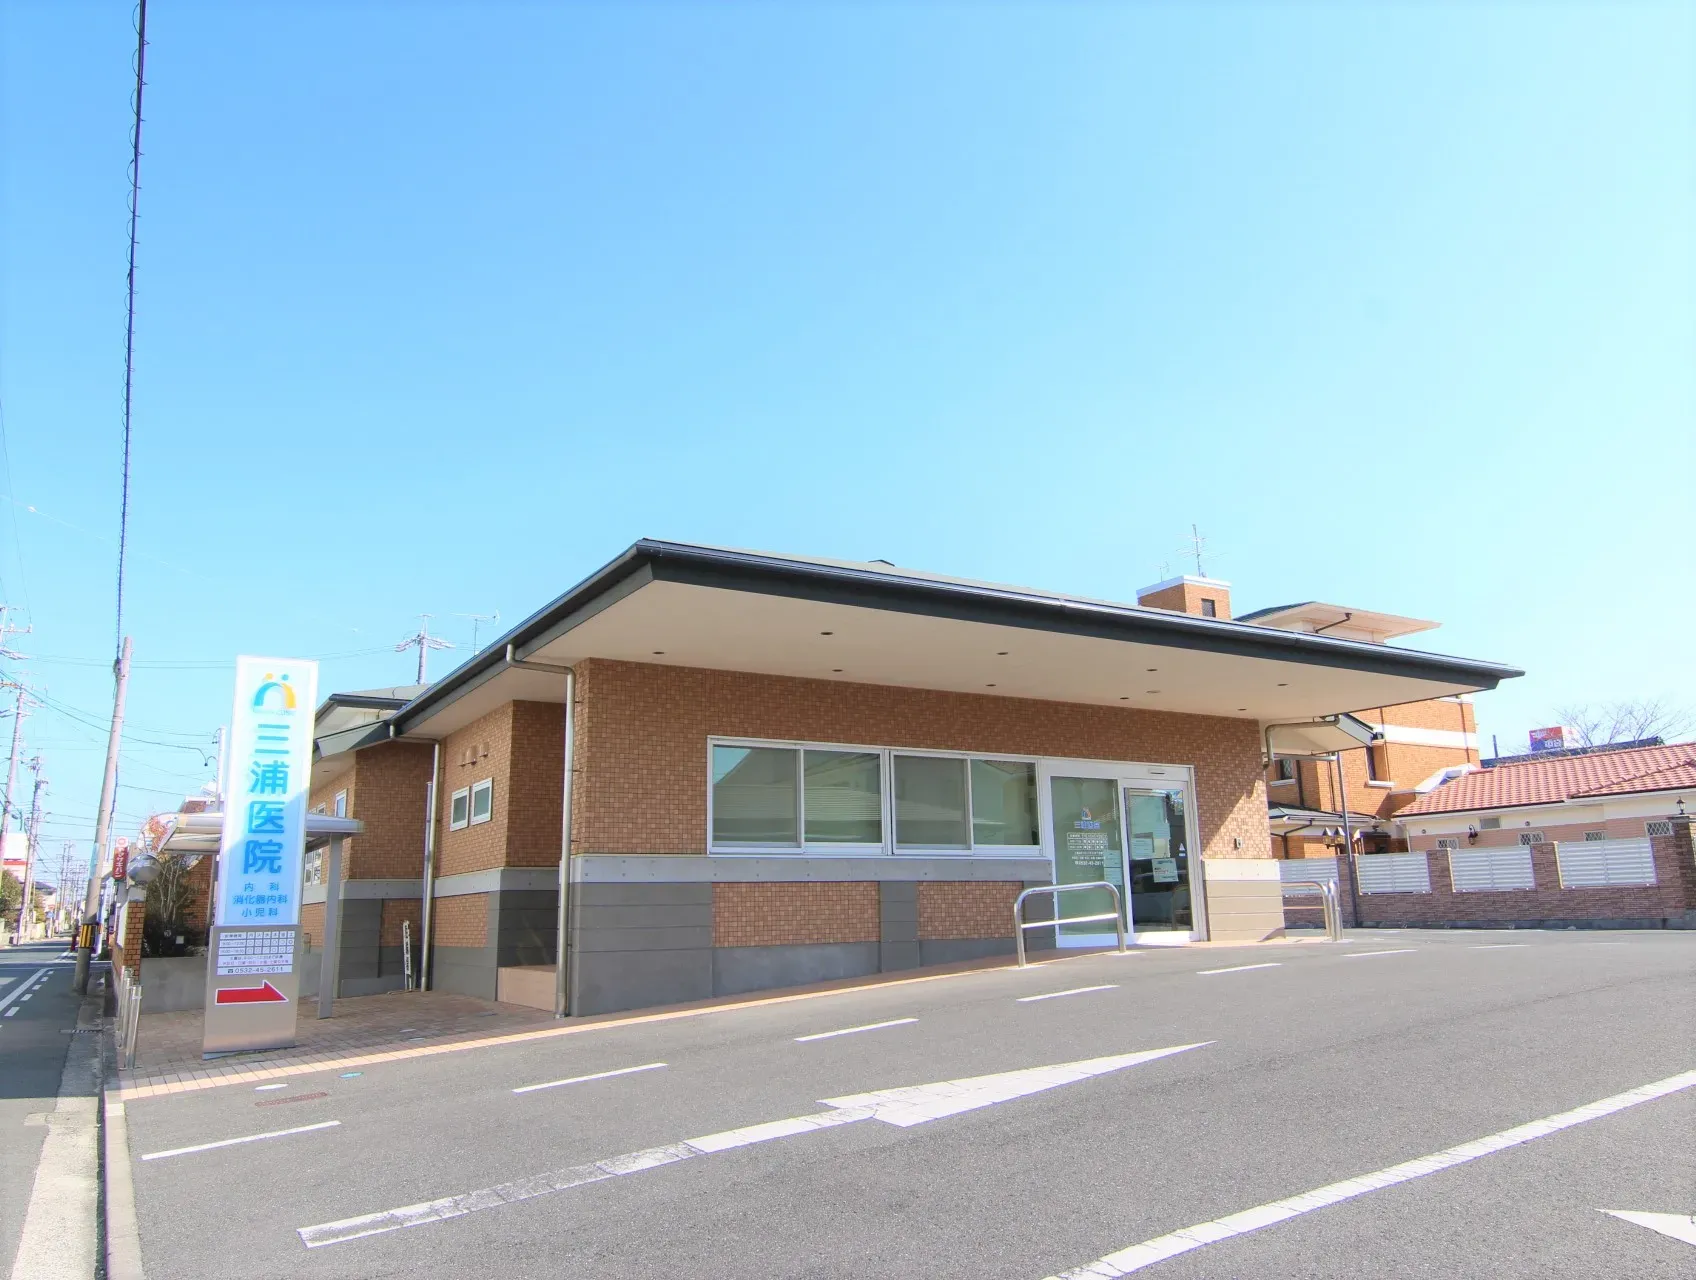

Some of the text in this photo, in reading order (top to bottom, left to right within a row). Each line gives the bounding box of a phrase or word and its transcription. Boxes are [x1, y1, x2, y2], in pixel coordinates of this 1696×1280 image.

[243, 723, 290, 874] 三浦医院
[244, 882, 279, 892] 内科
[233, 895, 287, 904] 消化器内科
[242, 908, 278, 917] 小児科
